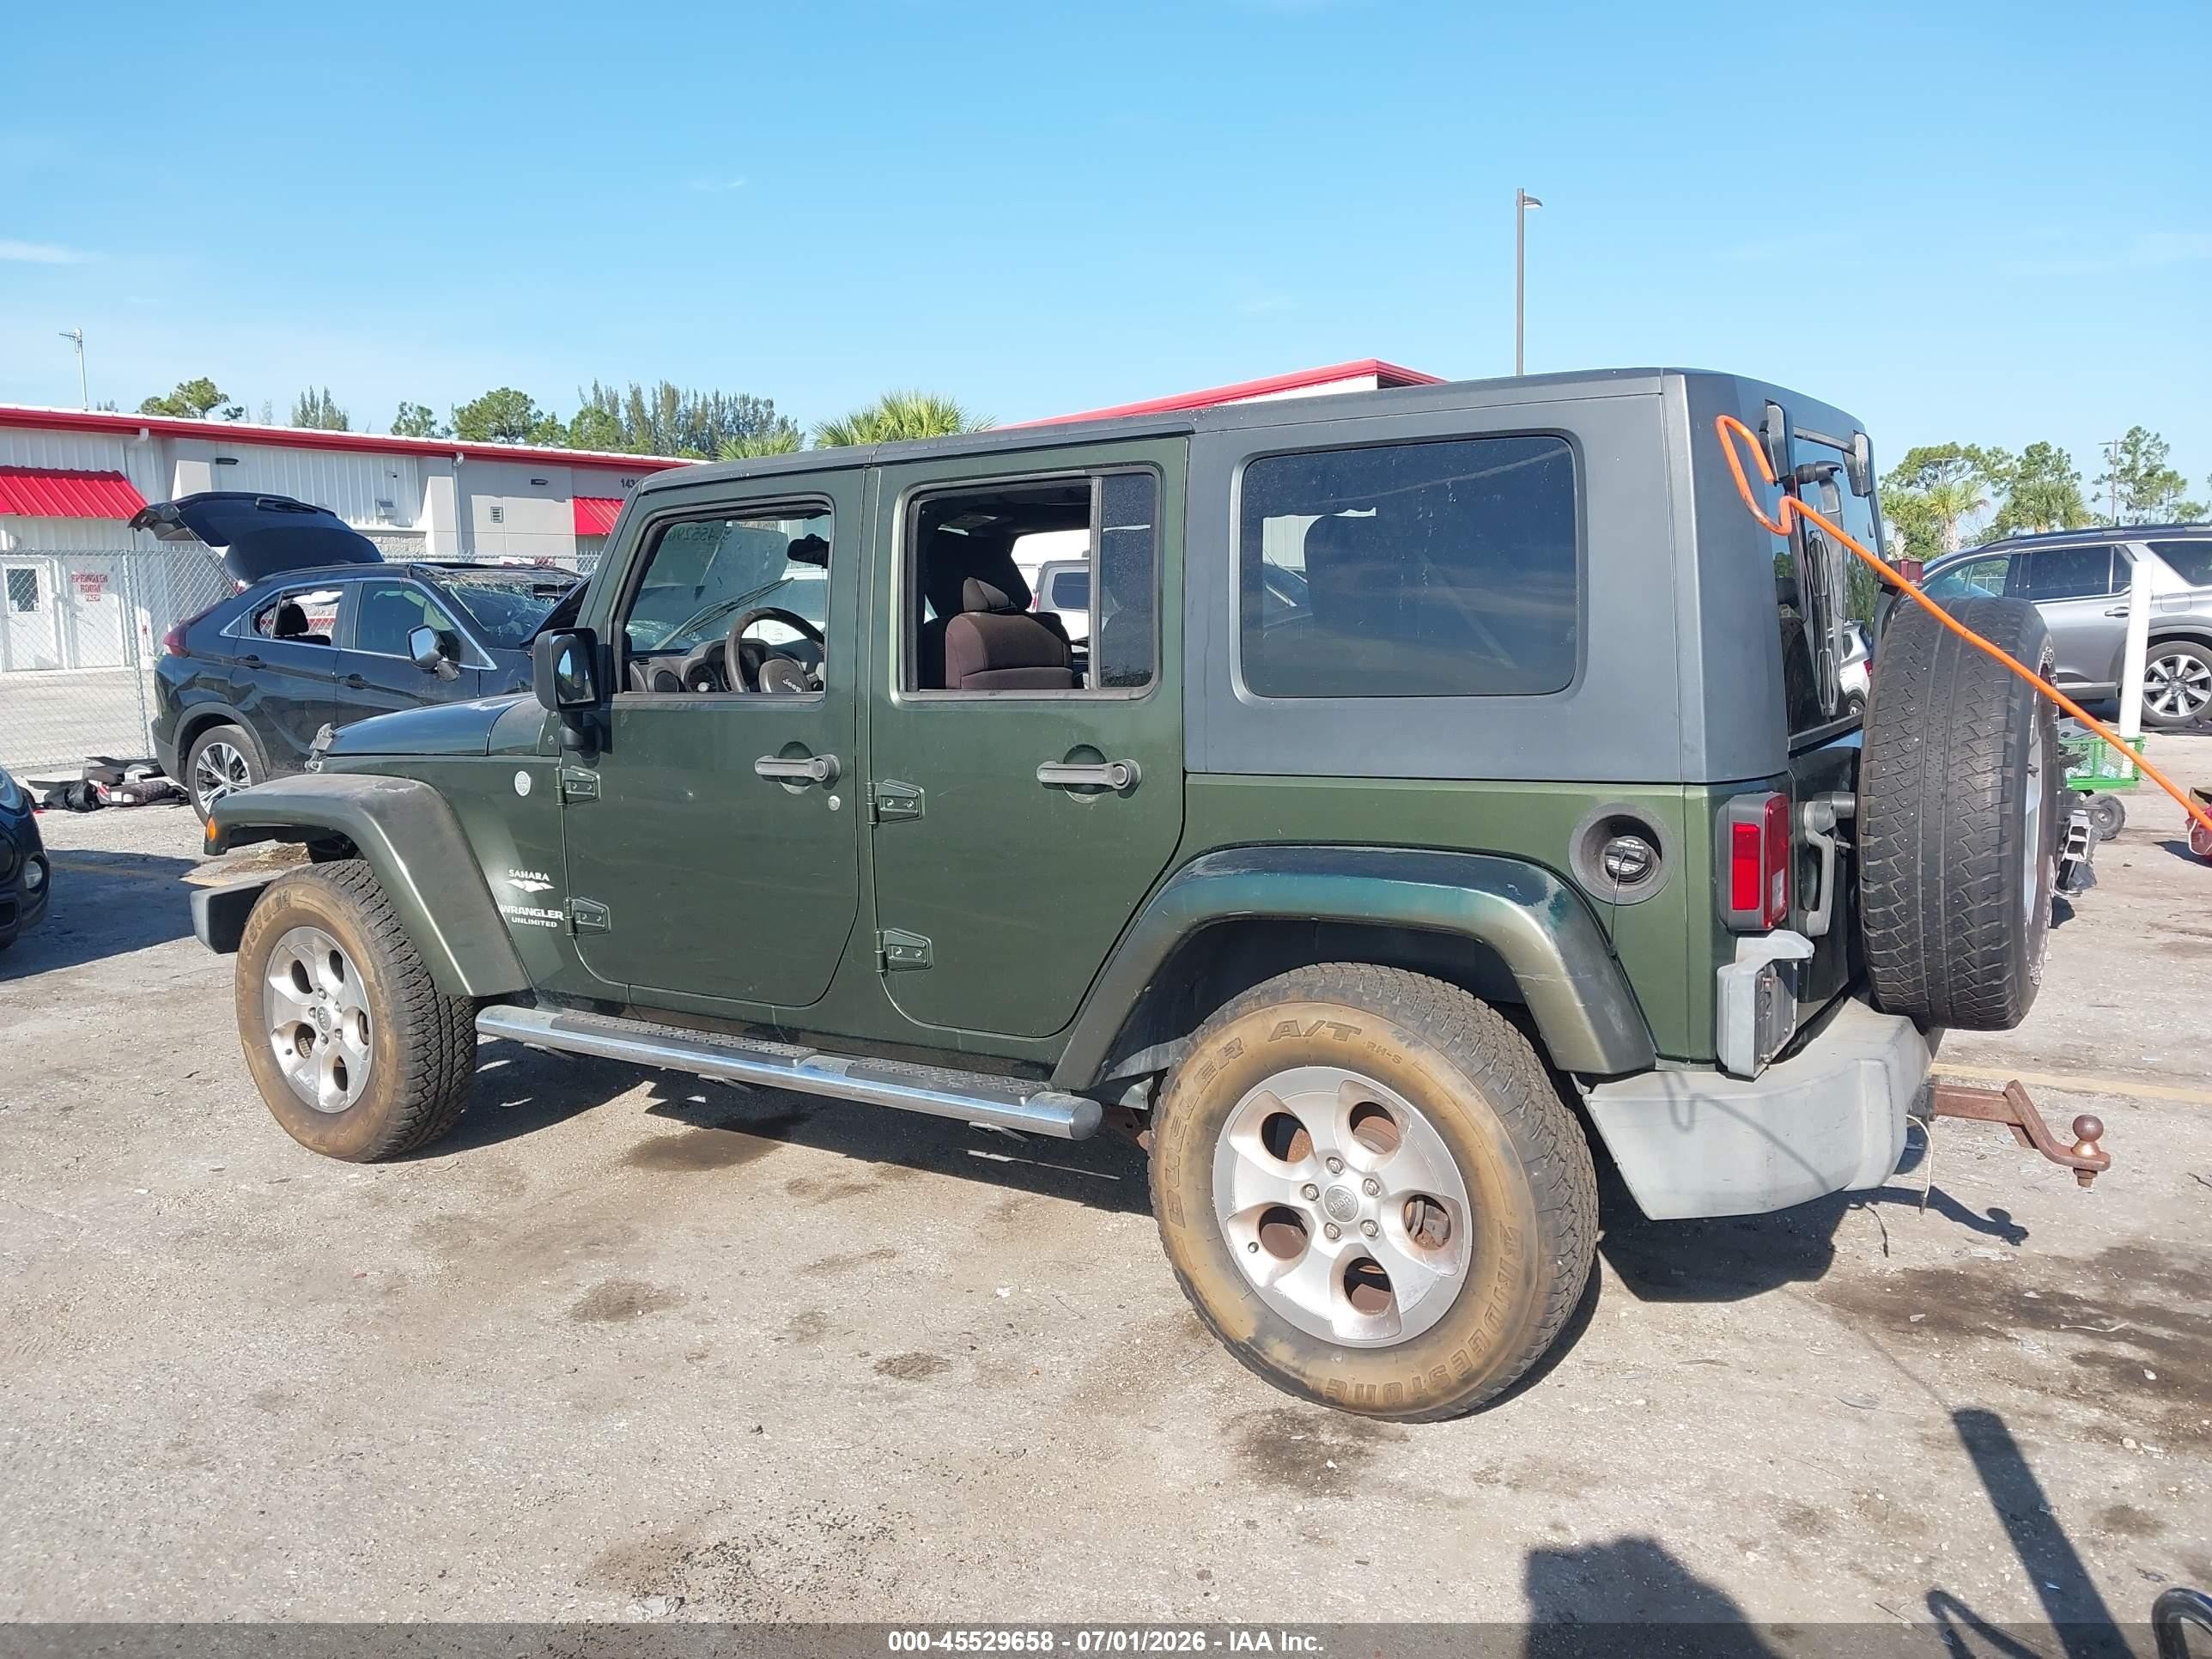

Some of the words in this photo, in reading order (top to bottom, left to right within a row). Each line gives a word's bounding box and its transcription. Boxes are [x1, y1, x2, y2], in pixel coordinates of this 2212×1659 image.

[620, 478, 640, 489] 143
[508, 869, 550, 882] SAHARA
[501, 905, 564, 921] WRANGLER
[511, 916, 557, 928] UNLIMITED
[1267, 1019, 1363, 1042] A/T
[1328, 1195, 1352, 1214] Jeep
